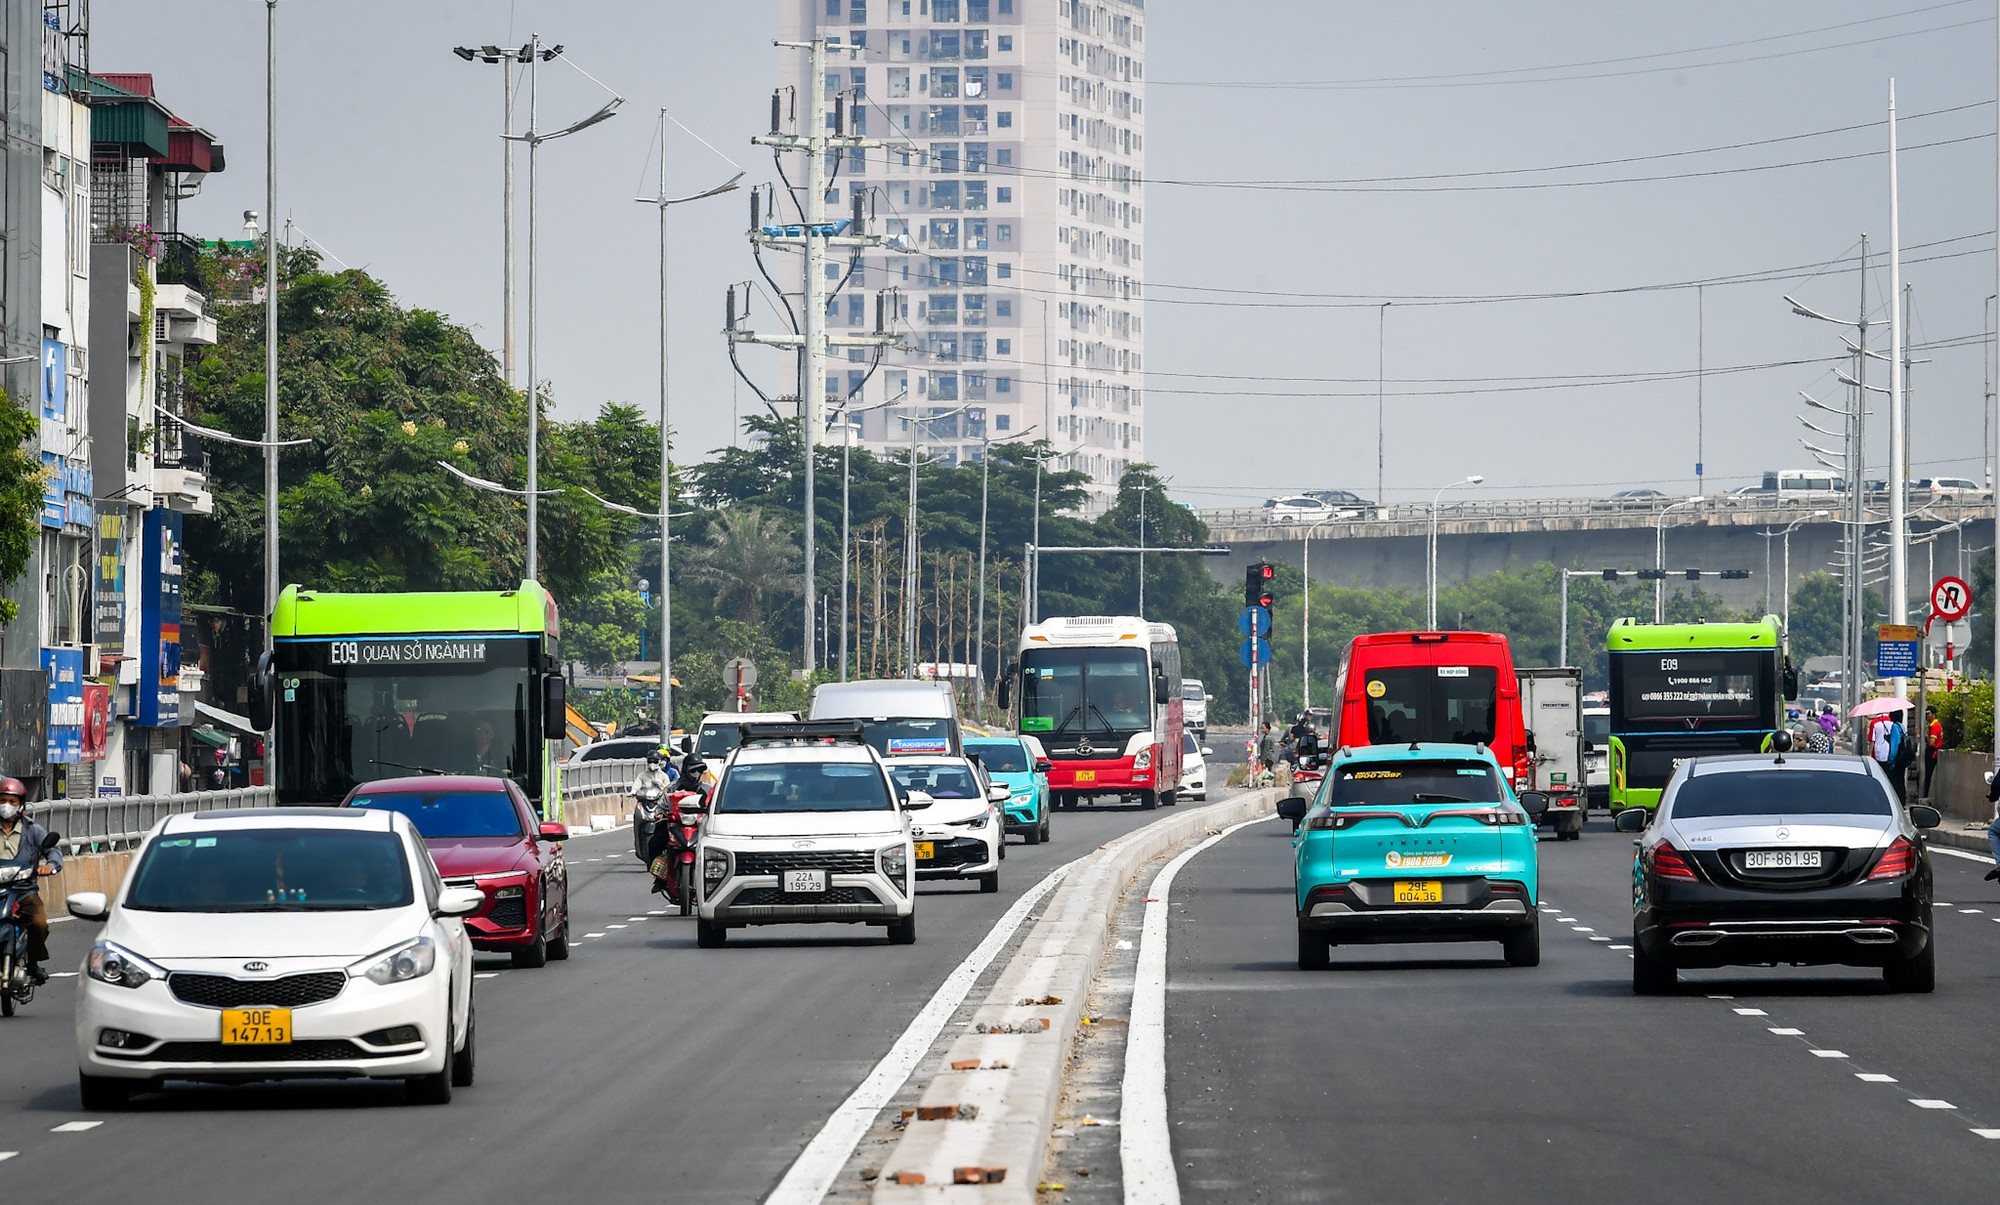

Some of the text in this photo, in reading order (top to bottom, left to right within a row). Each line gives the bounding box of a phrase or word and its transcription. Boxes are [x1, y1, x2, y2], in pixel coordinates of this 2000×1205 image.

[331, 642, 358, 664] E09
[362, 644, 400, 663] QUAN
[403, 640, 422, 660] SỞ
[425, 641, 470, 660] NGÀNH
[1661, 658, 1678, 671] E09
[1663, 691, 1673, 701] 355
[1673, 691, 1683, 701] 222
[1377, 837, 1458, 846] VINFAST
[1402, 856, 1443, 866] 1900 2088
[796, 872, 814, 882] 22A
[790, 881, 822, 891] 195.29
[1408, 882, 1428, 891] 29E
[1400, 892, 1436, 901] 004.36
[246, 962, 269, 971] KIA
[242, 1011, 271, 1025] 30E
[231, 1027, 284, 1042] 147.13
